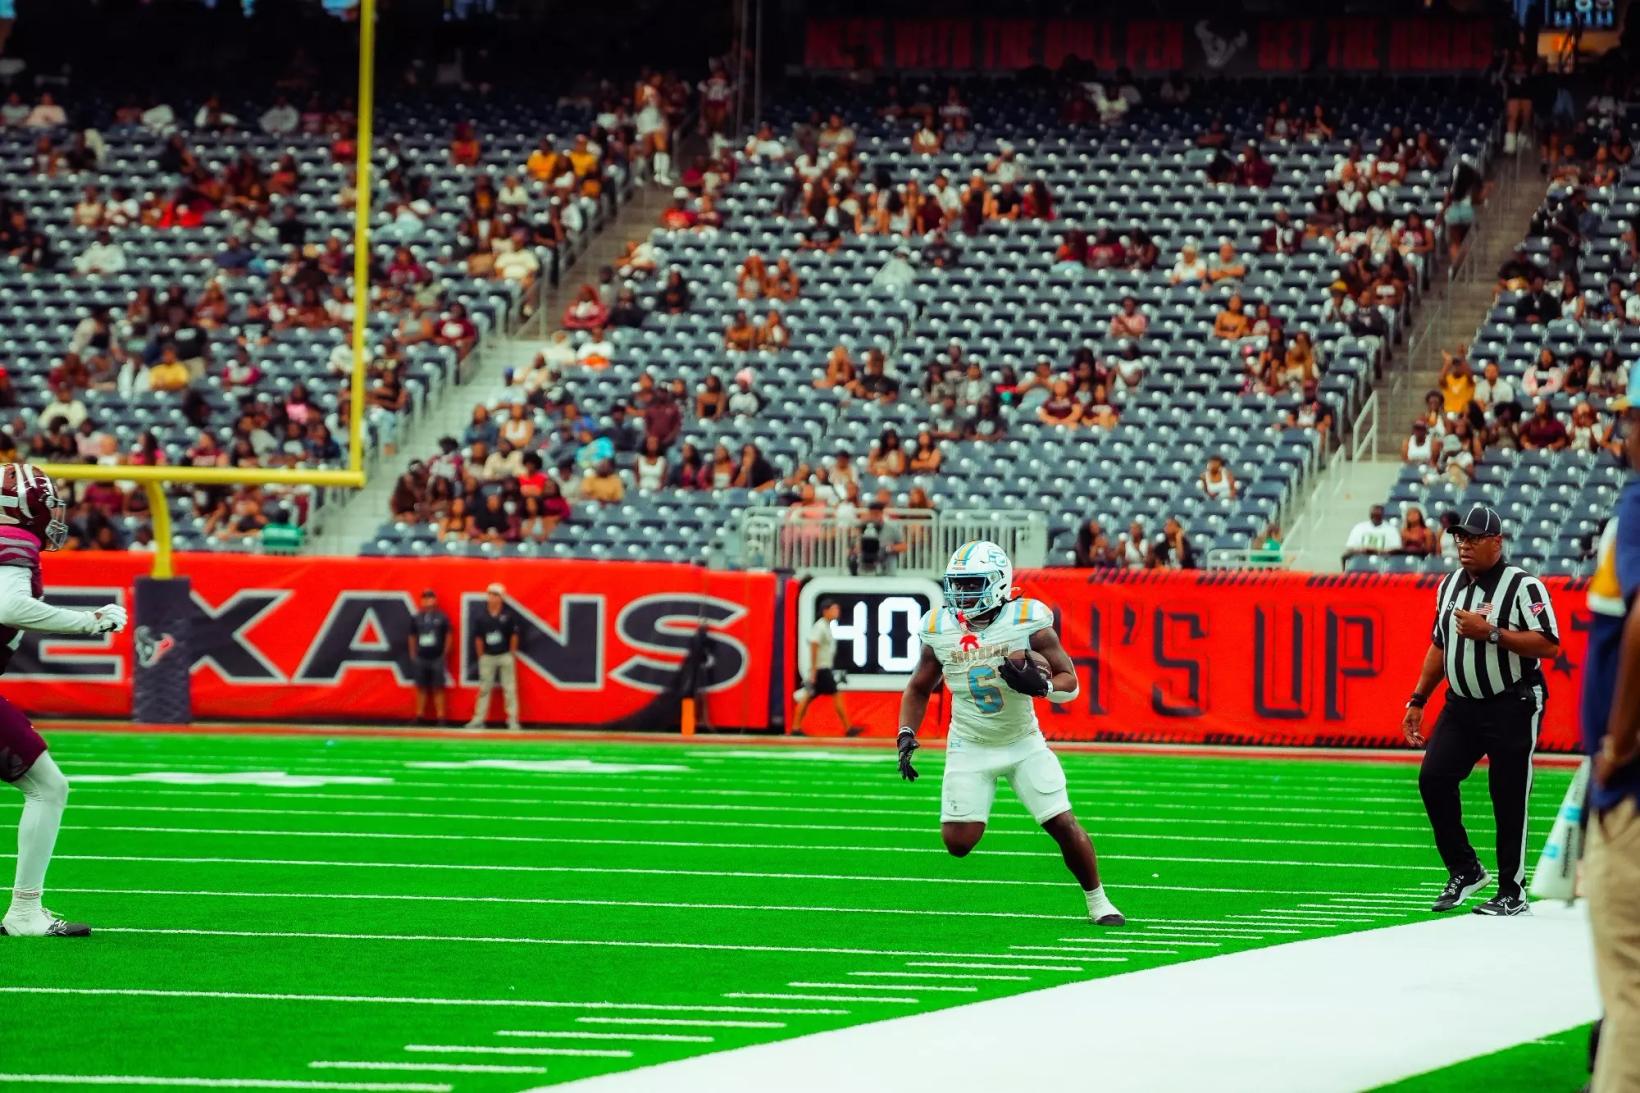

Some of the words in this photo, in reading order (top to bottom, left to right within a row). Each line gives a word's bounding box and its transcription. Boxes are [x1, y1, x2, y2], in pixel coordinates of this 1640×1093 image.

[829, 597, 921, 672] 40
[1253, 602, 1384, 720] UP
[967, 664, 1006, 714] 6
